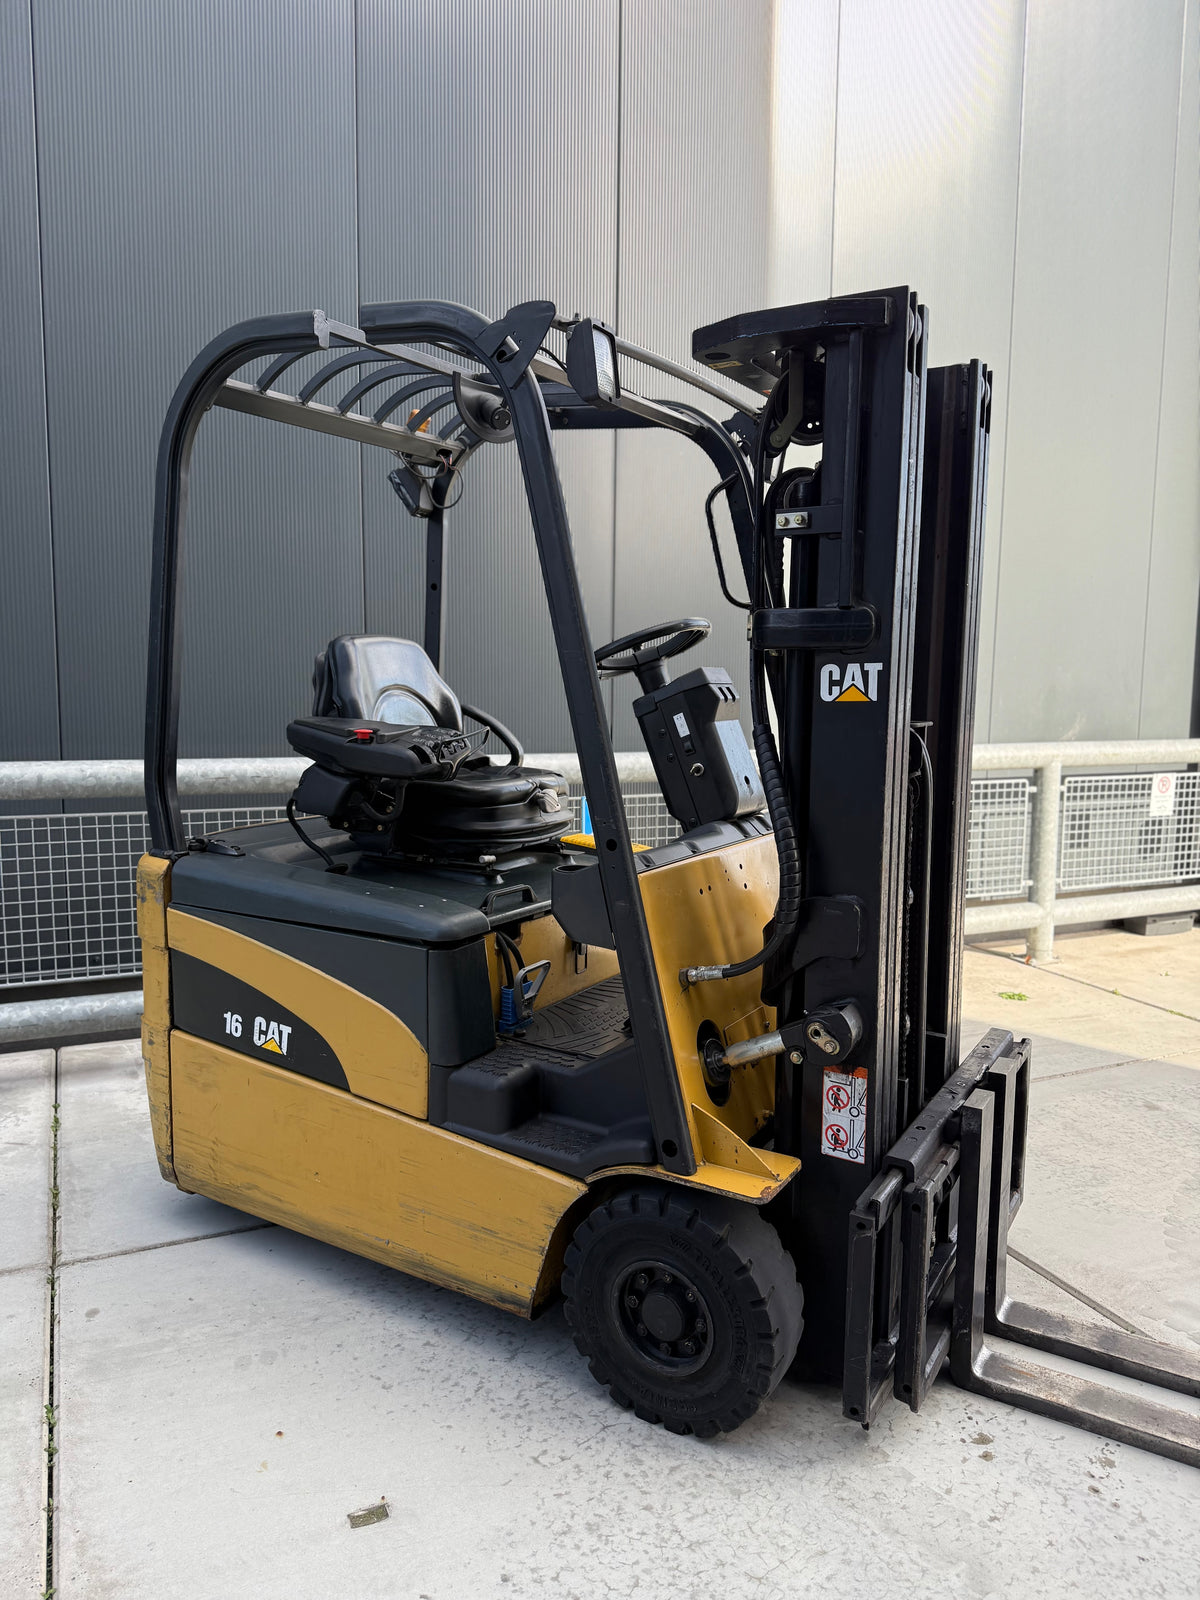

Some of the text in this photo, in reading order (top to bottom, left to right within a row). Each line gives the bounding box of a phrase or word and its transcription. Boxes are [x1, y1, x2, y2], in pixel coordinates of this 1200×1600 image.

[820, 662, 883, 702] CAT
[223, 1011, 292, 1056] 16 CAT
